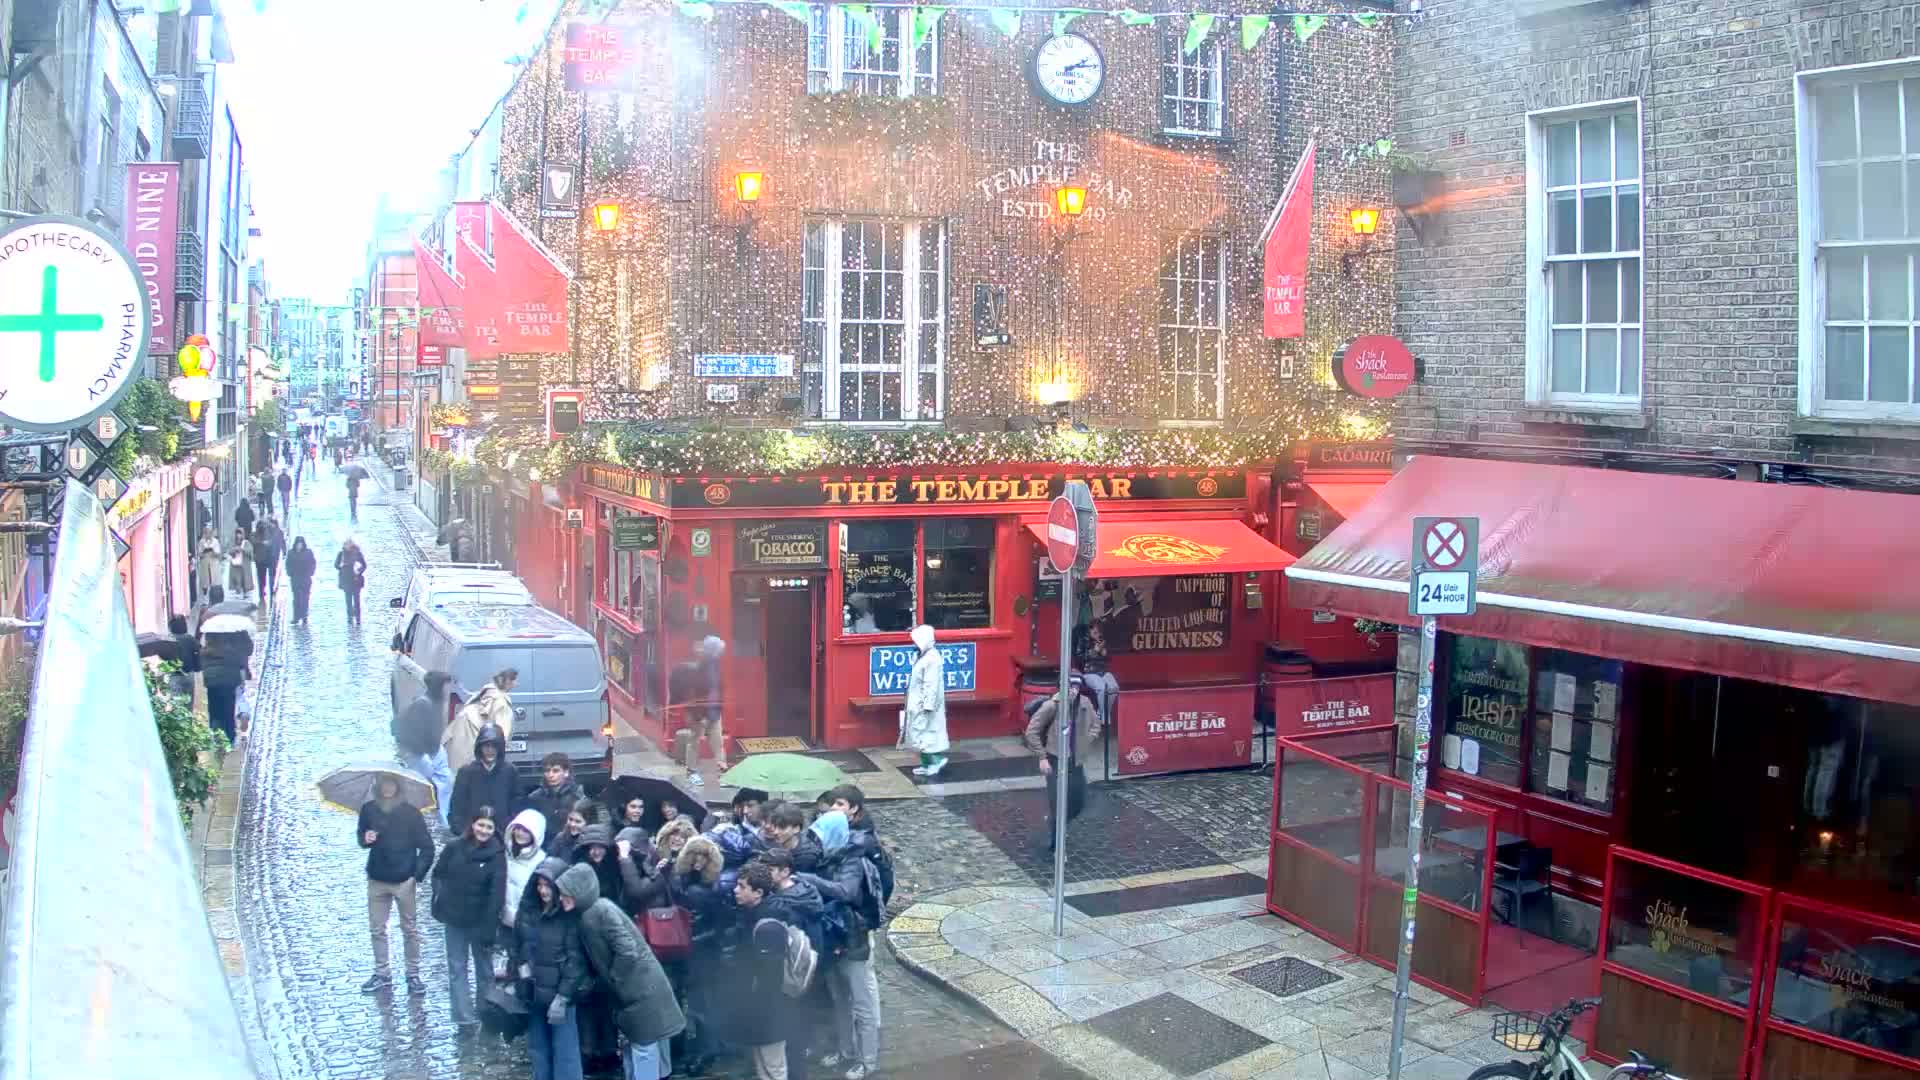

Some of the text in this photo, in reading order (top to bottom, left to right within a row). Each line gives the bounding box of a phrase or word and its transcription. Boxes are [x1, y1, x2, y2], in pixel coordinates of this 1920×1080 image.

[1033, 139, 1082, 163] THE
[975, 163, 1133, 209] TEMPLE BAR
[136, 171, 169, 232] NINE
[504, 311, 565, 324] TEMPLE
[519, 324, 552, 337] BAR
[88, 302, 136, 401] PHARMACY
[635, 476, 652, 499] BAR
[823, 480, 898, 504] THE
[911, 478, 1050, 502] TEMPLE
[750, 538, 816, 561] TOBACCO
[873, 554, 889, 562] THE
[1175, 577, 1225, 593] EMPEROR
[1420, 583, 1459, 603] 24 Uair
[1211, 593, 1225, 608] OF
[1443, 594, 1465, 602] HOUR
[1132, 631, 1224, 650] GUINNESS
[879, 648, 968, 667] POWR'S
[873, 670, 973, 690] WHEY
[1302, 705, 1371, 722] TEMPLE BAR
[1327, 701, 1345, 710] THE
[1147, 716, 1227, 733] TEMPLE BAR
[1178, 711, 1199, 721] THE
[1645, 899, 1689, 929] Shack
